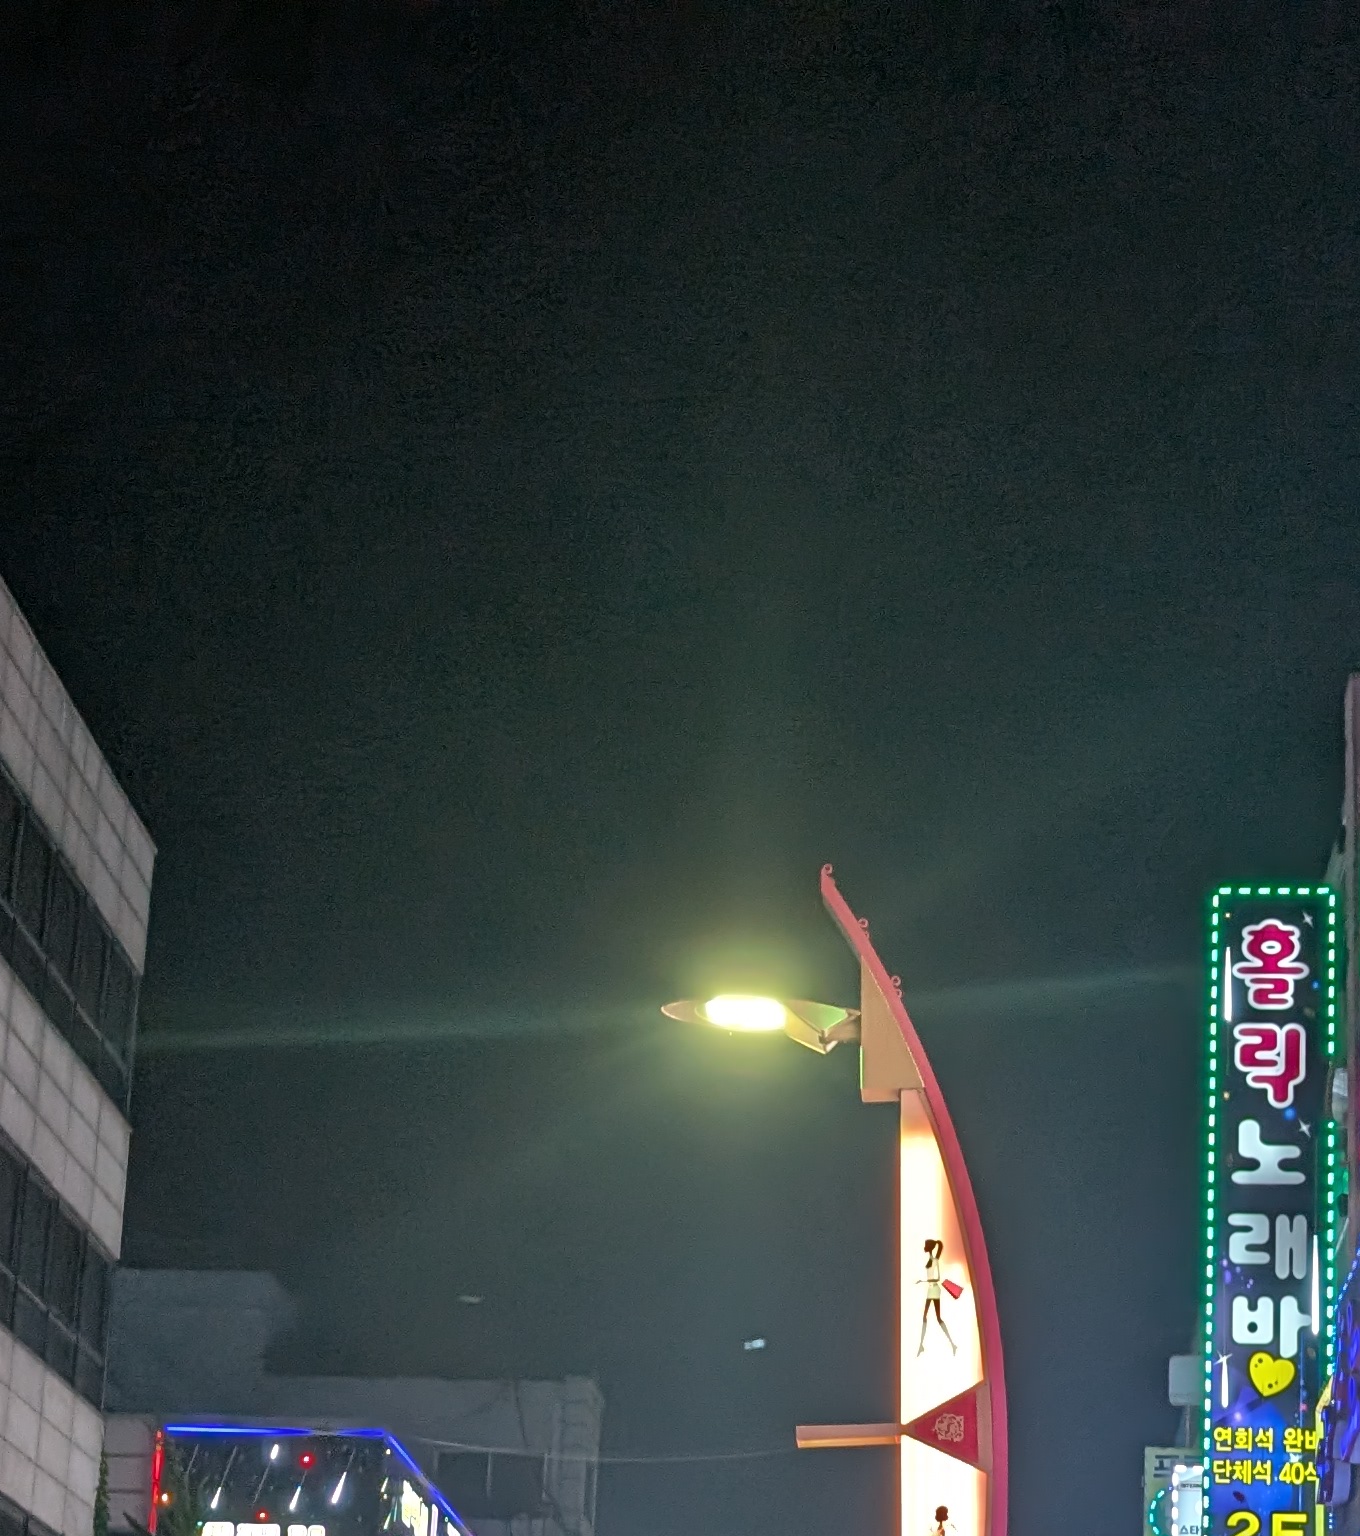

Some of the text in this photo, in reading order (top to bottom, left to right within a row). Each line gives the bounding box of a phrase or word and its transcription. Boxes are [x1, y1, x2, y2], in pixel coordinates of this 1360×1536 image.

[1232, 917, 1310, 1110] 홀릭
[1213, 1427, 1274, 1453] 연회석
[1212, 1459, 1273, 1486] 단체석
